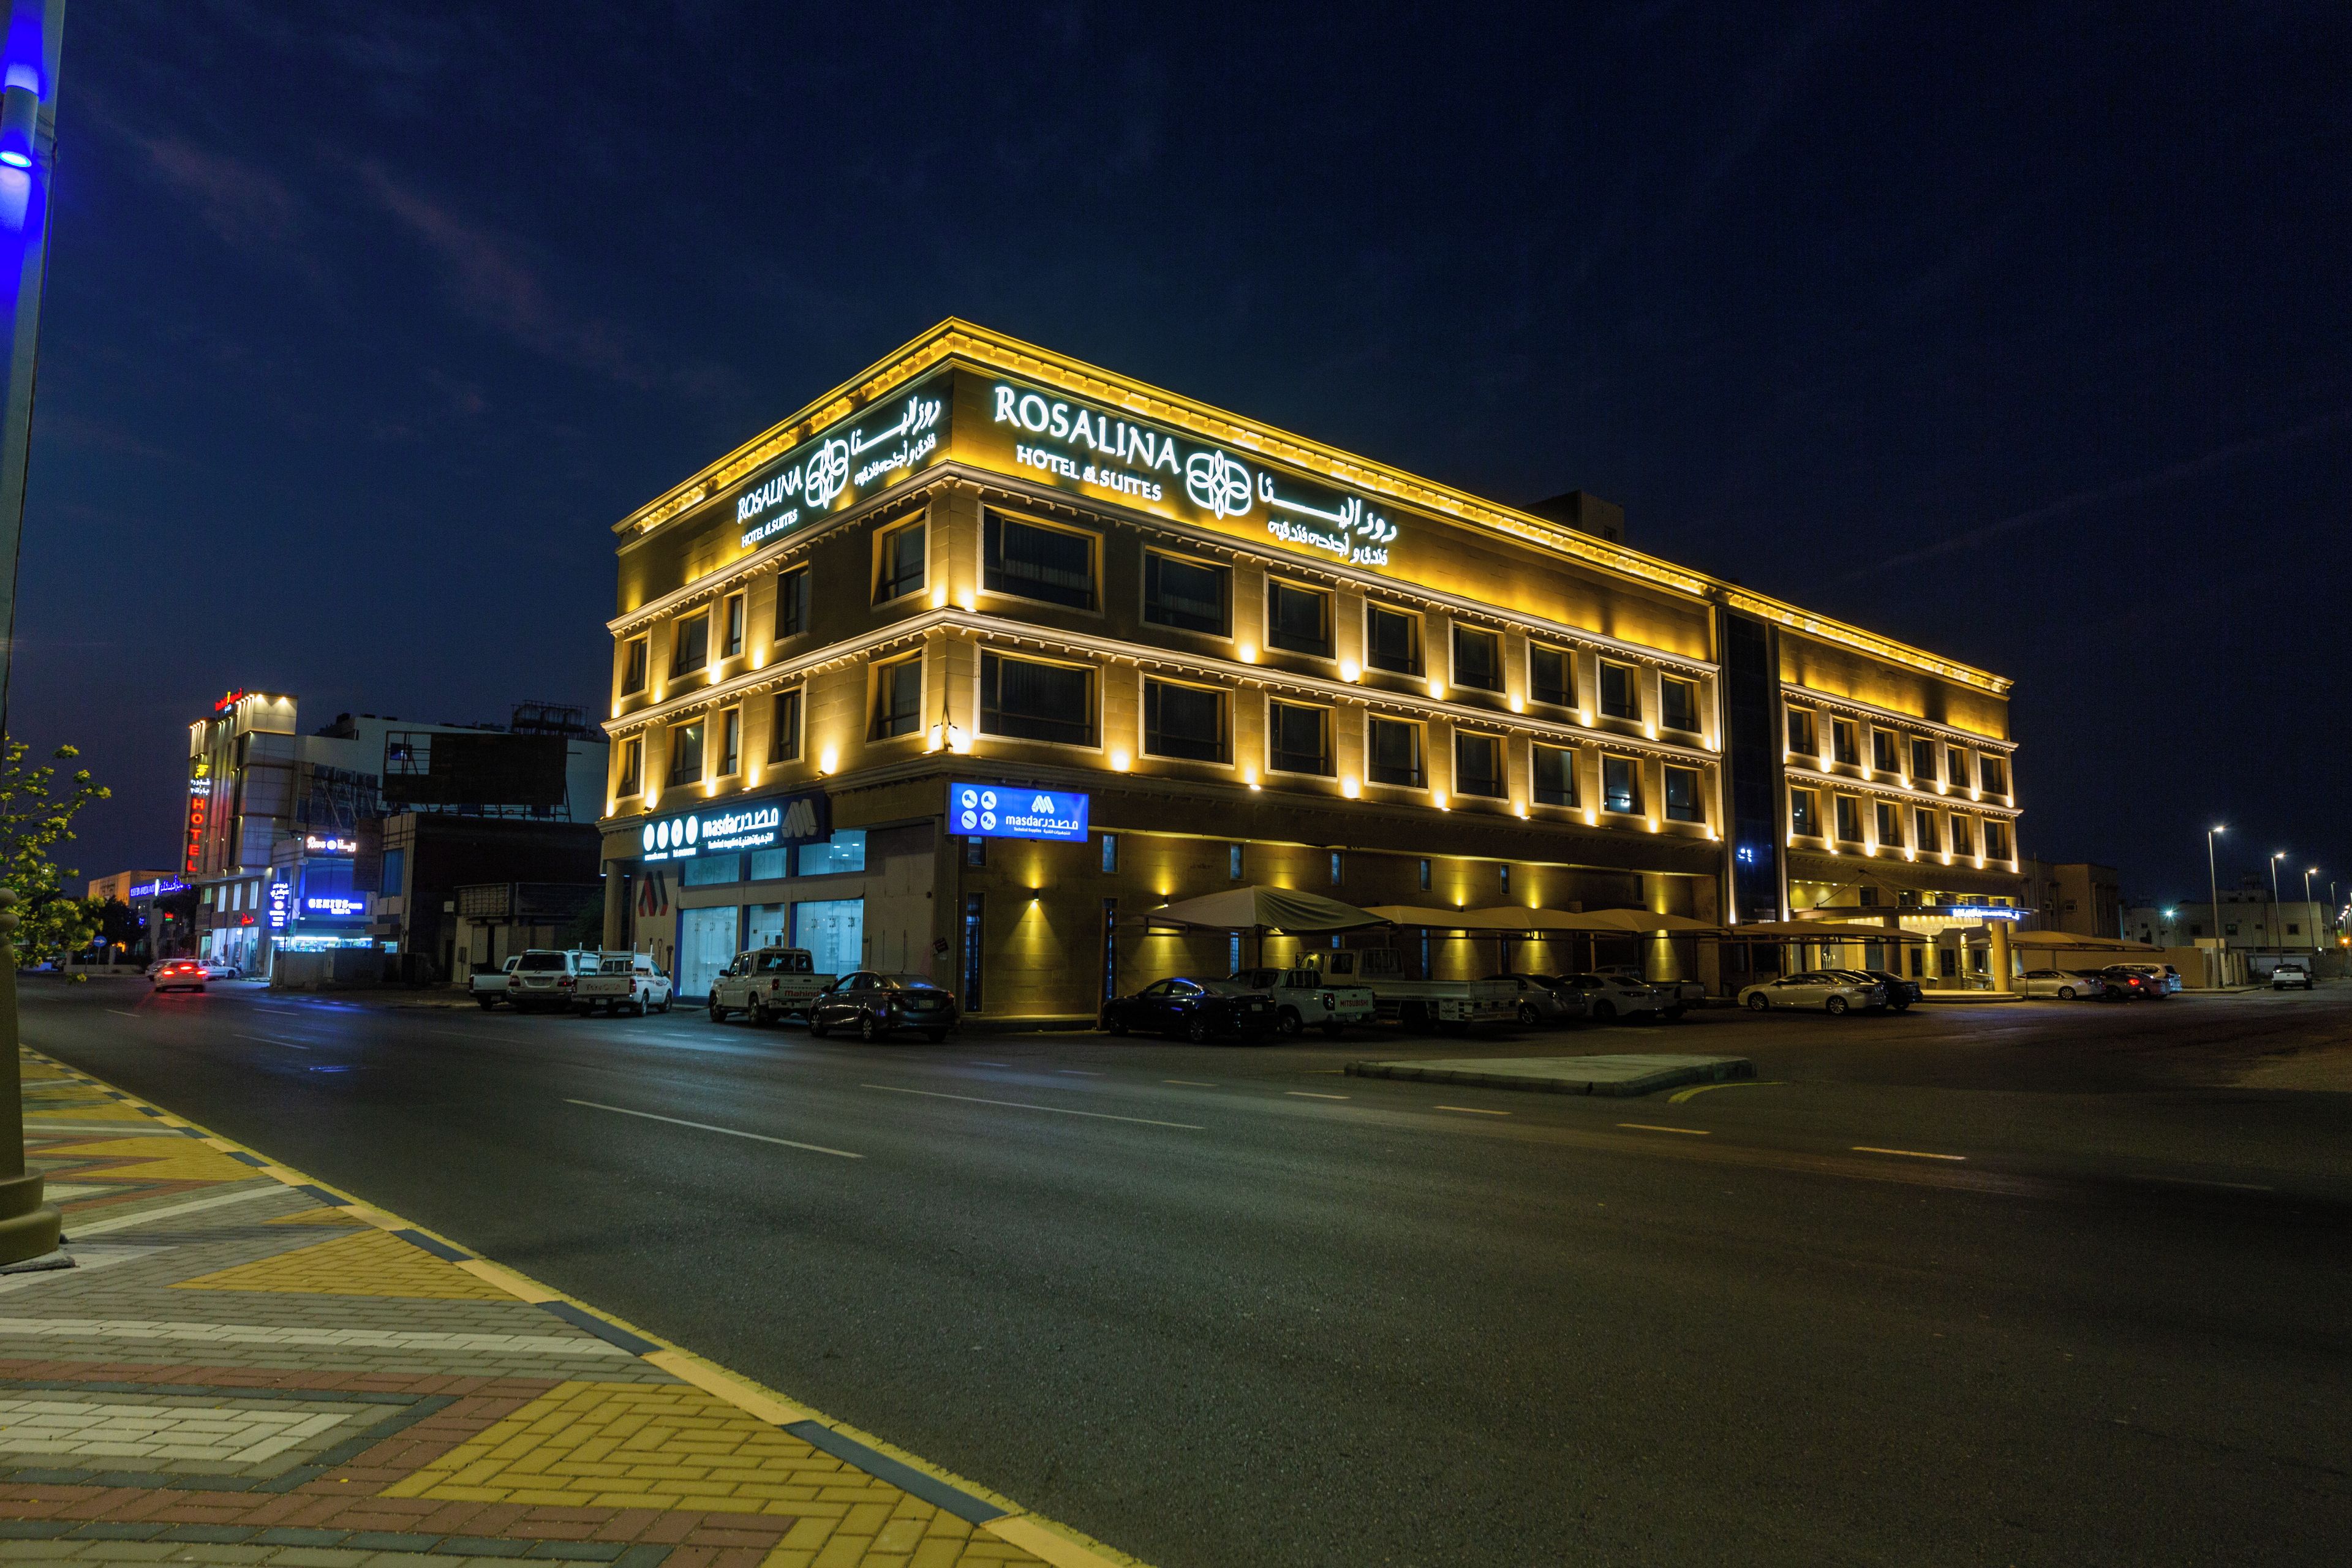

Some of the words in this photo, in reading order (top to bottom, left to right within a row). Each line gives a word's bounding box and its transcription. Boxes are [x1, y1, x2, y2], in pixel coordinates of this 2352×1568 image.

[995, 386, 1182, 475] ROSALINA
[1016, 445, 1080, 480] HOTEL
[1082, 466, 1099, 484] &
[1098, 470, 1163, 502] SUITES
[737, 466, 804, 524] ROSALINA
[741, 527, 765, 548] HOTEL
[764, 522, 772, 536] &
[771, 508, 798, 533] SUITES
[1360, 545, 1389, 567] فندق
[702, 813, 741, 838] masdar
[737, 807, 778, 832] مصدر
[1005, 815, 1044, 827] masdar
[1041, 818, 1079, 831] مصدر
[187, 797, 206, 872] HOTEL
[308, 898, 349, 909] GENIUS
[1340, 999, 1369, 1008] MITSUBISHI
